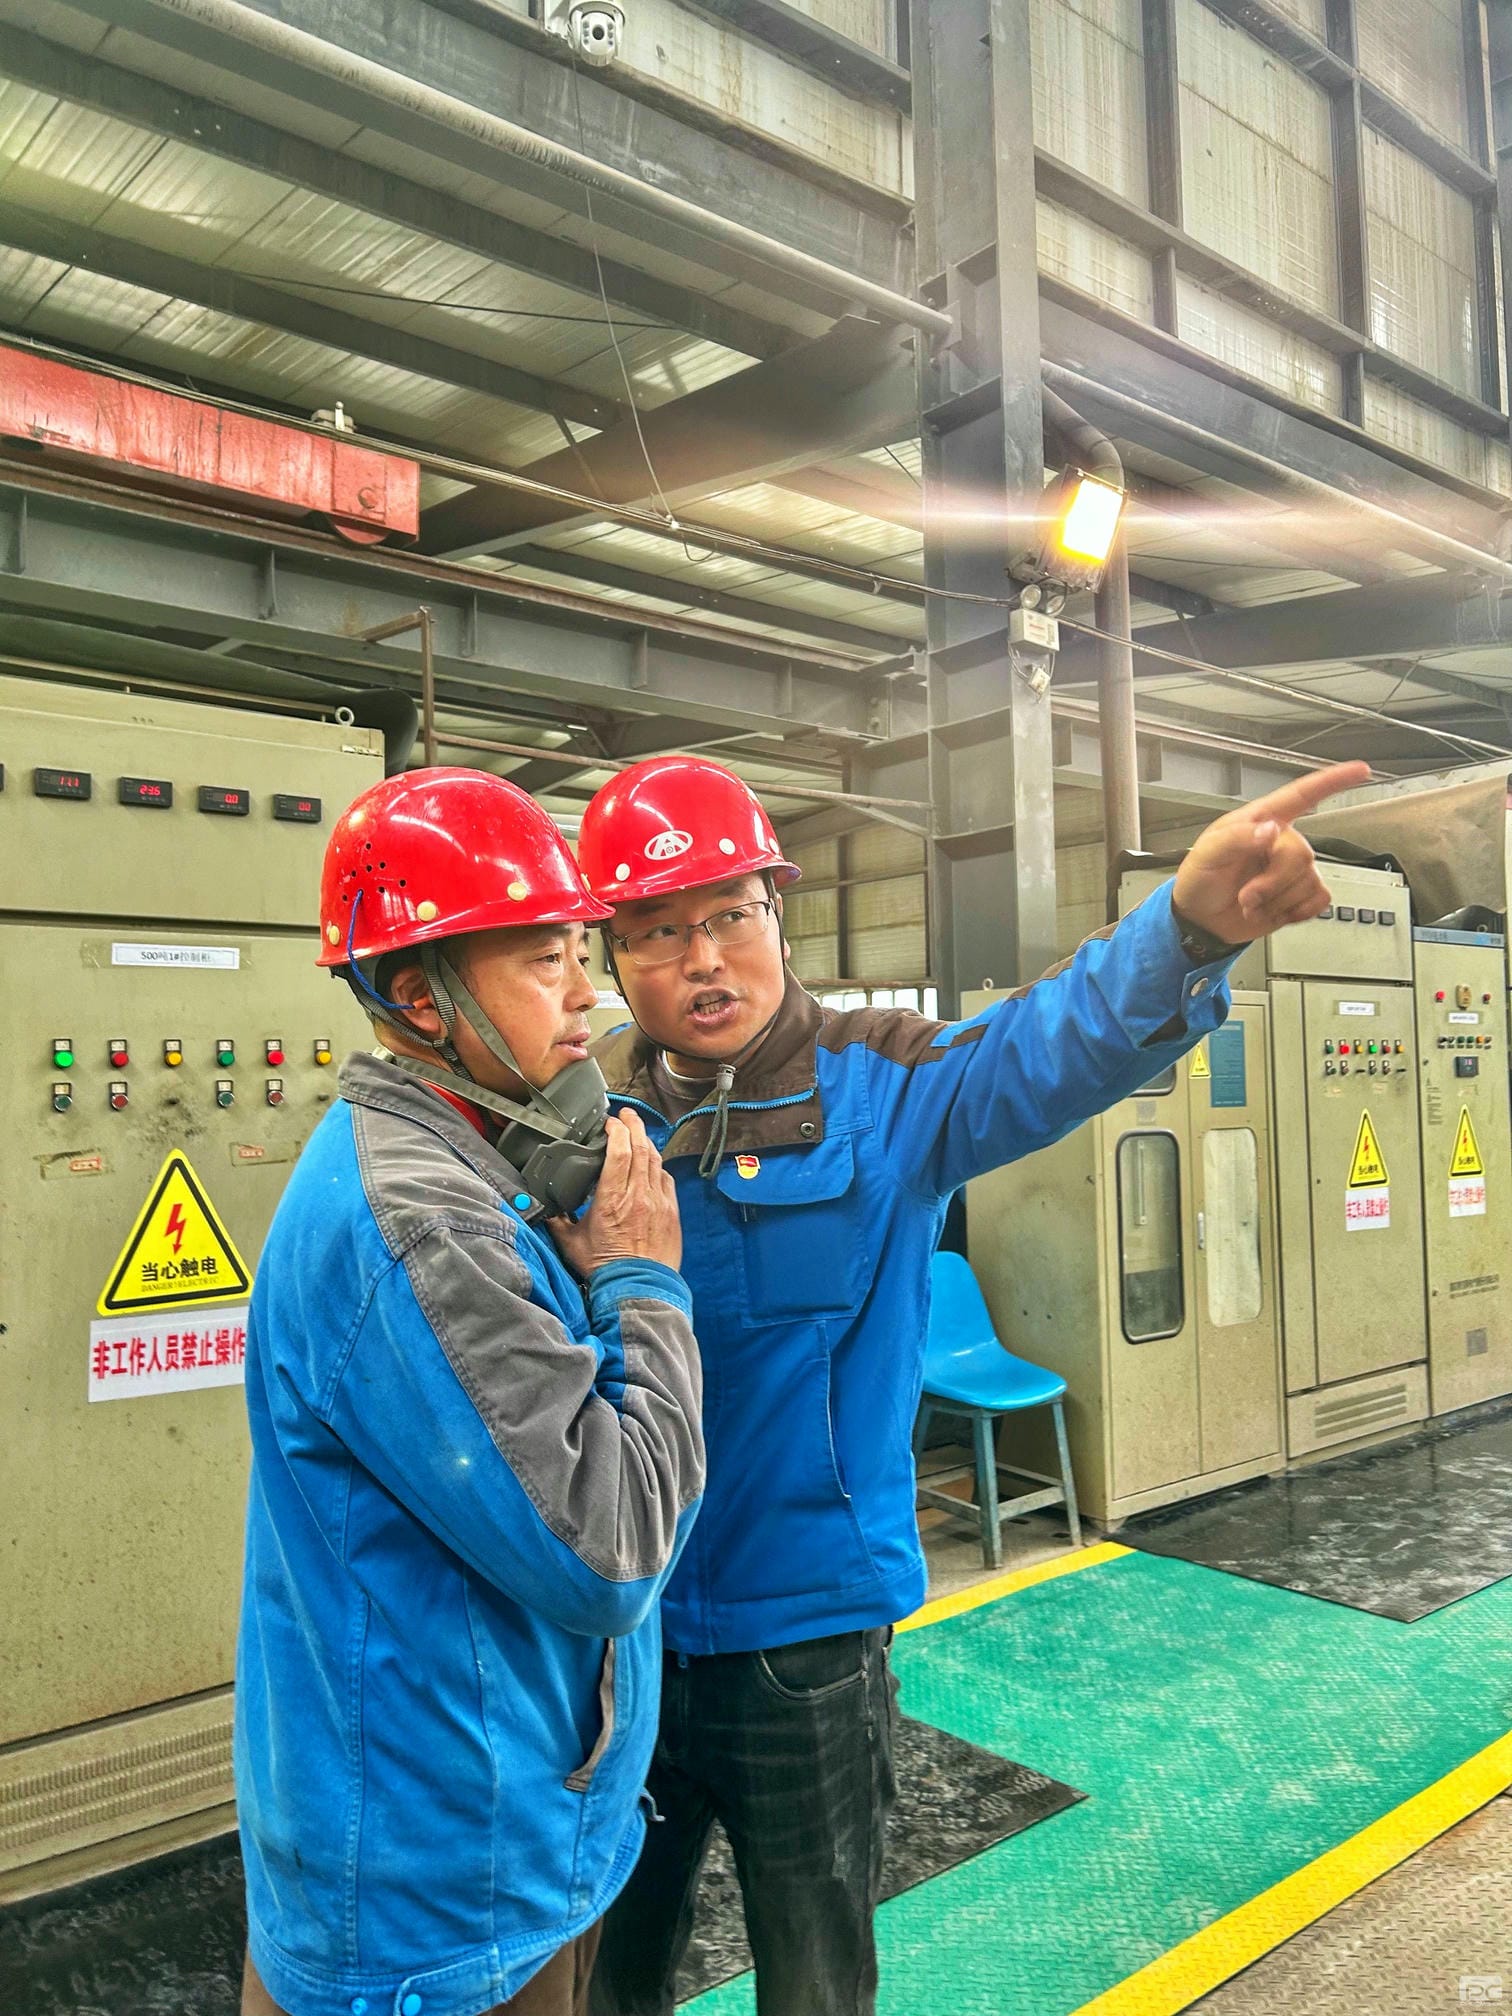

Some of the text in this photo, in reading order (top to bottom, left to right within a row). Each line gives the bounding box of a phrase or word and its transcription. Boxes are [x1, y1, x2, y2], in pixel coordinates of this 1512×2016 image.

[142, 1256, 218, 1281] 当心触电
[93, 1326, 246, 1380] 非工作人员禁止操作
